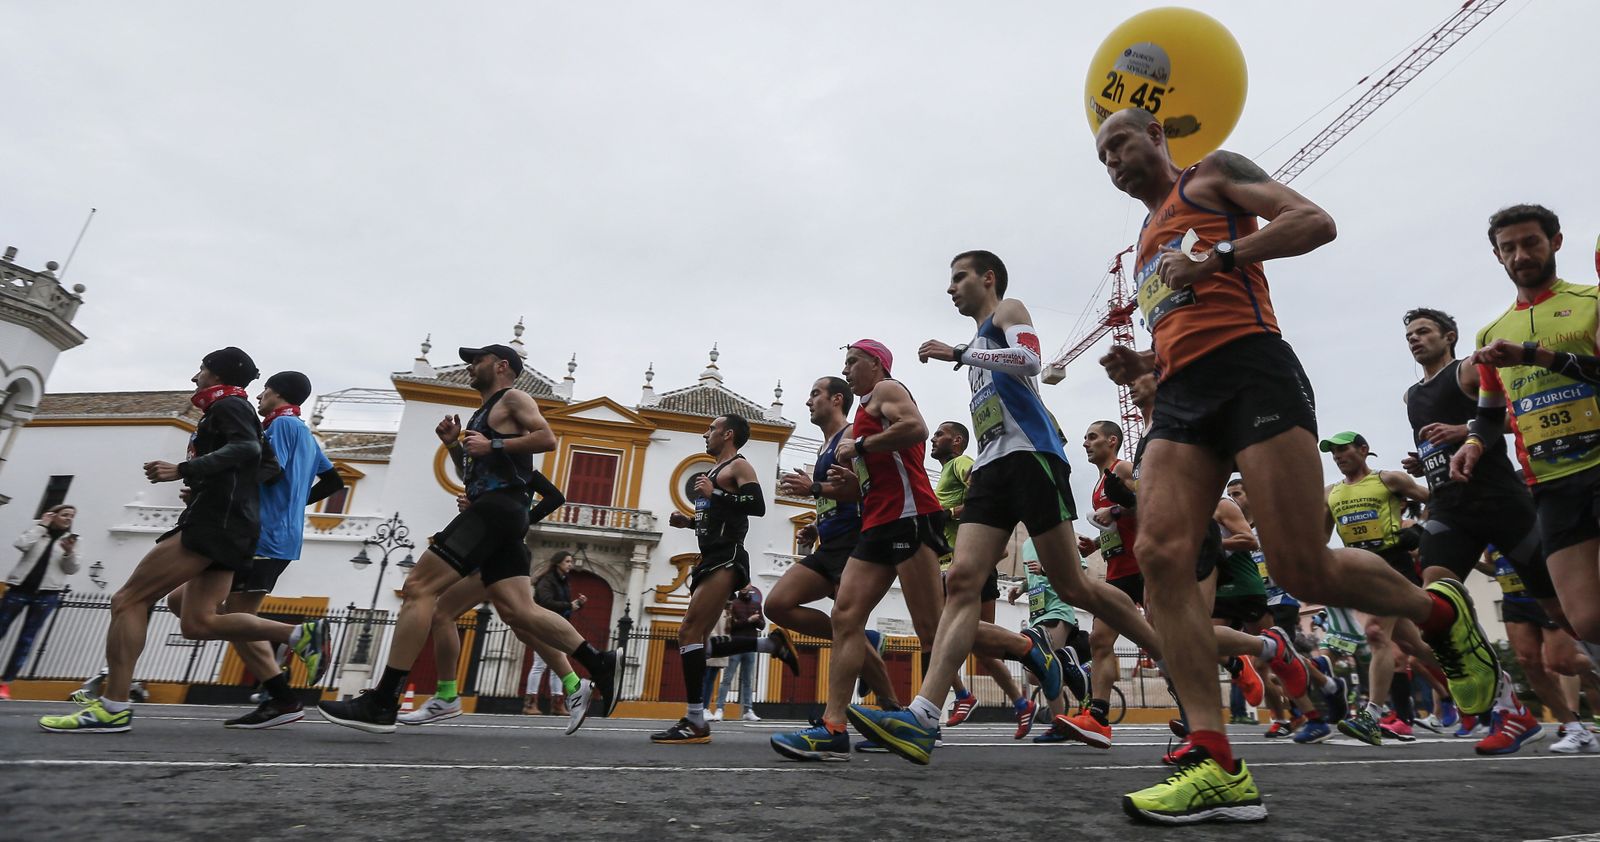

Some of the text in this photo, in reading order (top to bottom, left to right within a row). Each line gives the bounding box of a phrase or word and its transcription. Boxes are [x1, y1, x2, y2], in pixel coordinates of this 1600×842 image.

[1101, 70, 1125, 104] 2h
[1534, 388, 1582, 406] ZURICH
[1539, 410, 1572, 429] 393
[1424, 453, 1447, 471] 1614
[1348, 512, 1374, 523] ZURICH
[1352, 526, 1368, 536] 320
